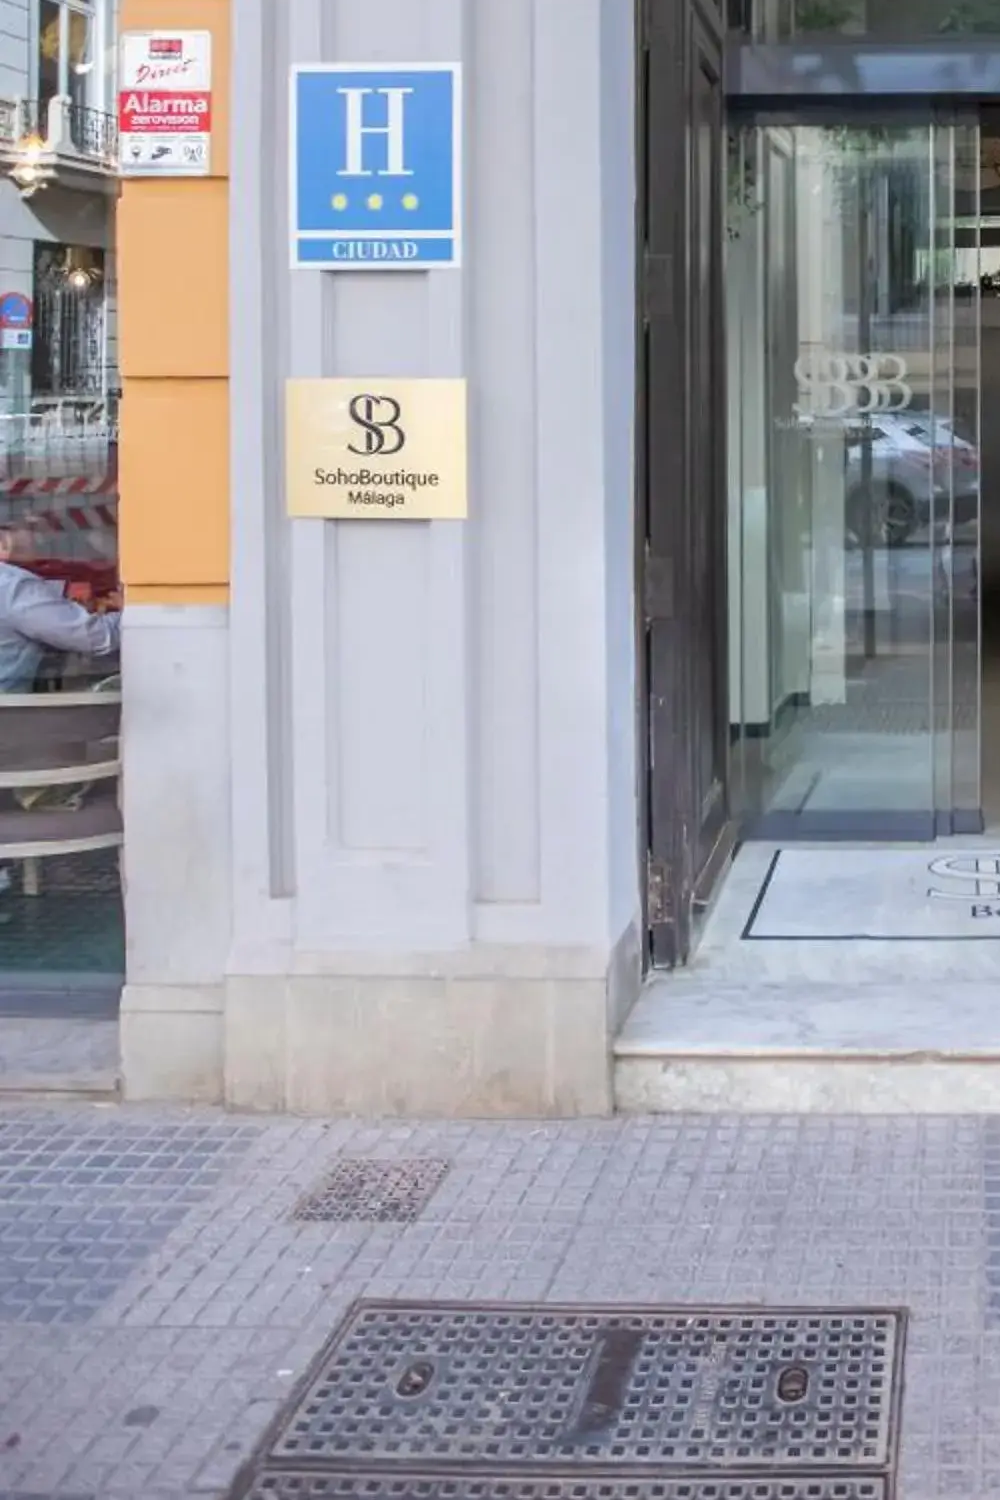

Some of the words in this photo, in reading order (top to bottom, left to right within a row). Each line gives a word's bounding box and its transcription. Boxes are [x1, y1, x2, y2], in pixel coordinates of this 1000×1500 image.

[123, 92, 208, 113] Alarma
[336, 87, 414, 176] H
[332, 240, 419, 260] CIUDAD
[314, 468, 440, 490] SohoBoutique
[347, 490, 406, 508] Málaga
